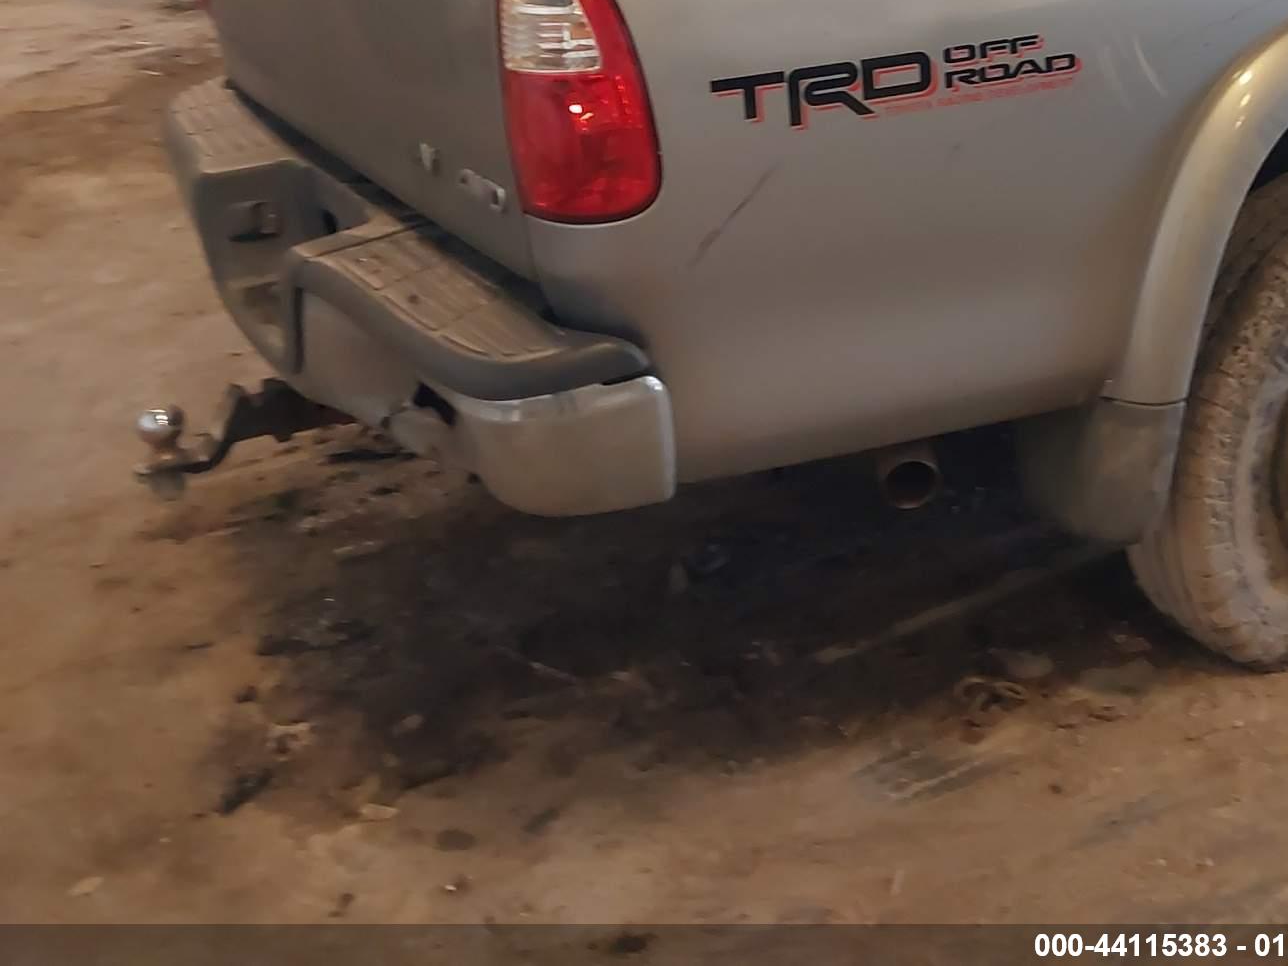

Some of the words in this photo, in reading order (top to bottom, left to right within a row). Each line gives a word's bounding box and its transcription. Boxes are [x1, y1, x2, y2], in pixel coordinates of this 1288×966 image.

[943, 34, 1044, 65] OFF
[710, 51, 937, 130] TRD
[944, 53, 1083, 92] ROAD
